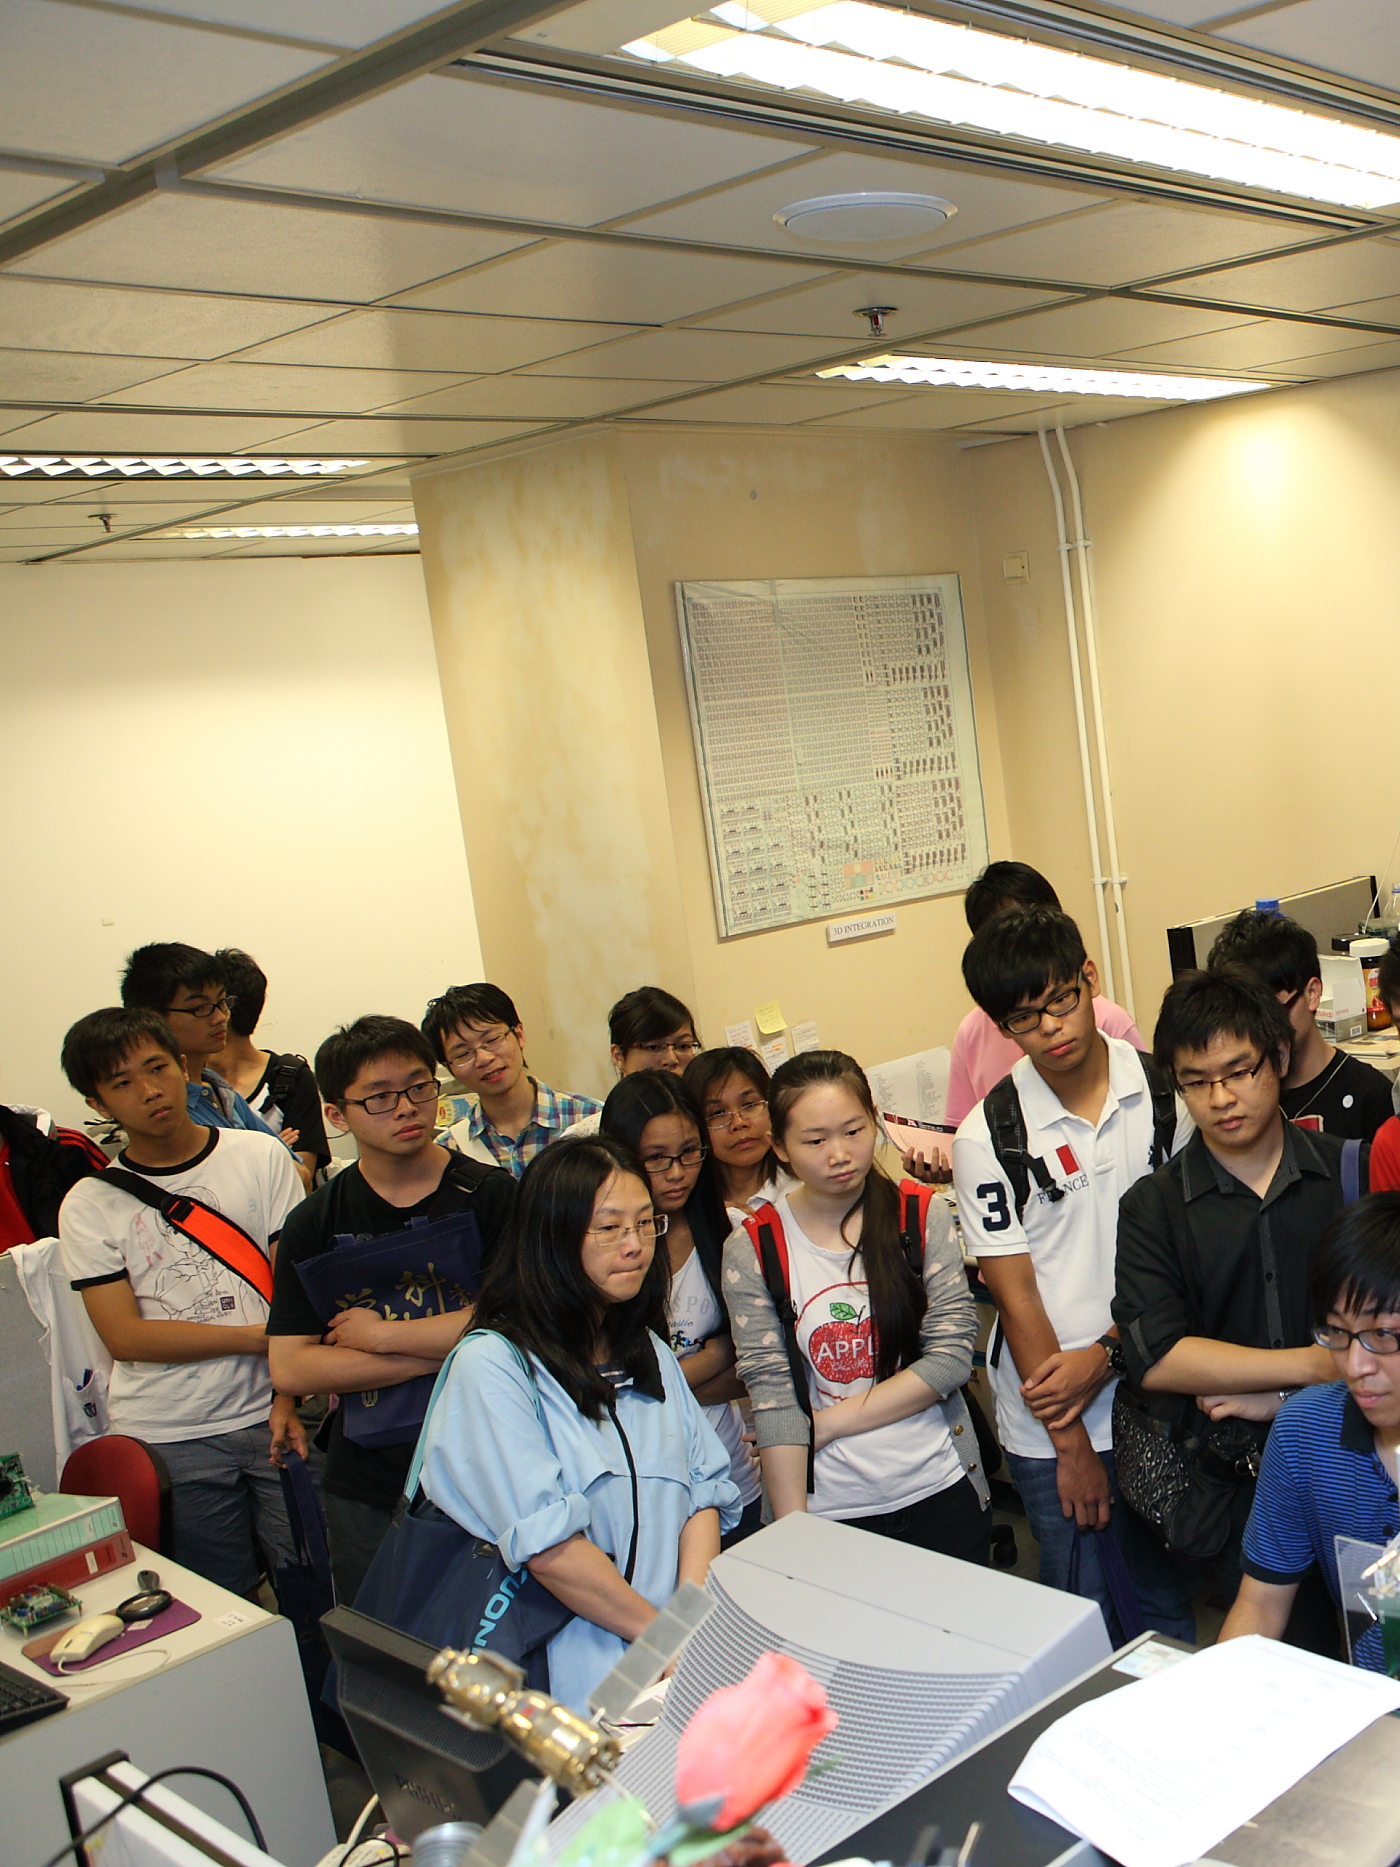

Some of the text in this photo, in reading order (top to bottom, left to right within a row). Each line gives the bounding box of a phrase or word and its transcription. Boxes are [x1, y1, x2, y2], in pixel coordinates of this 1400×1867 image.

[833, 916, 894, 936] 3D INTEGRATION
[976, 1181, 1012, 1232] 3
[817, 1334, 876, 1364] APPL
